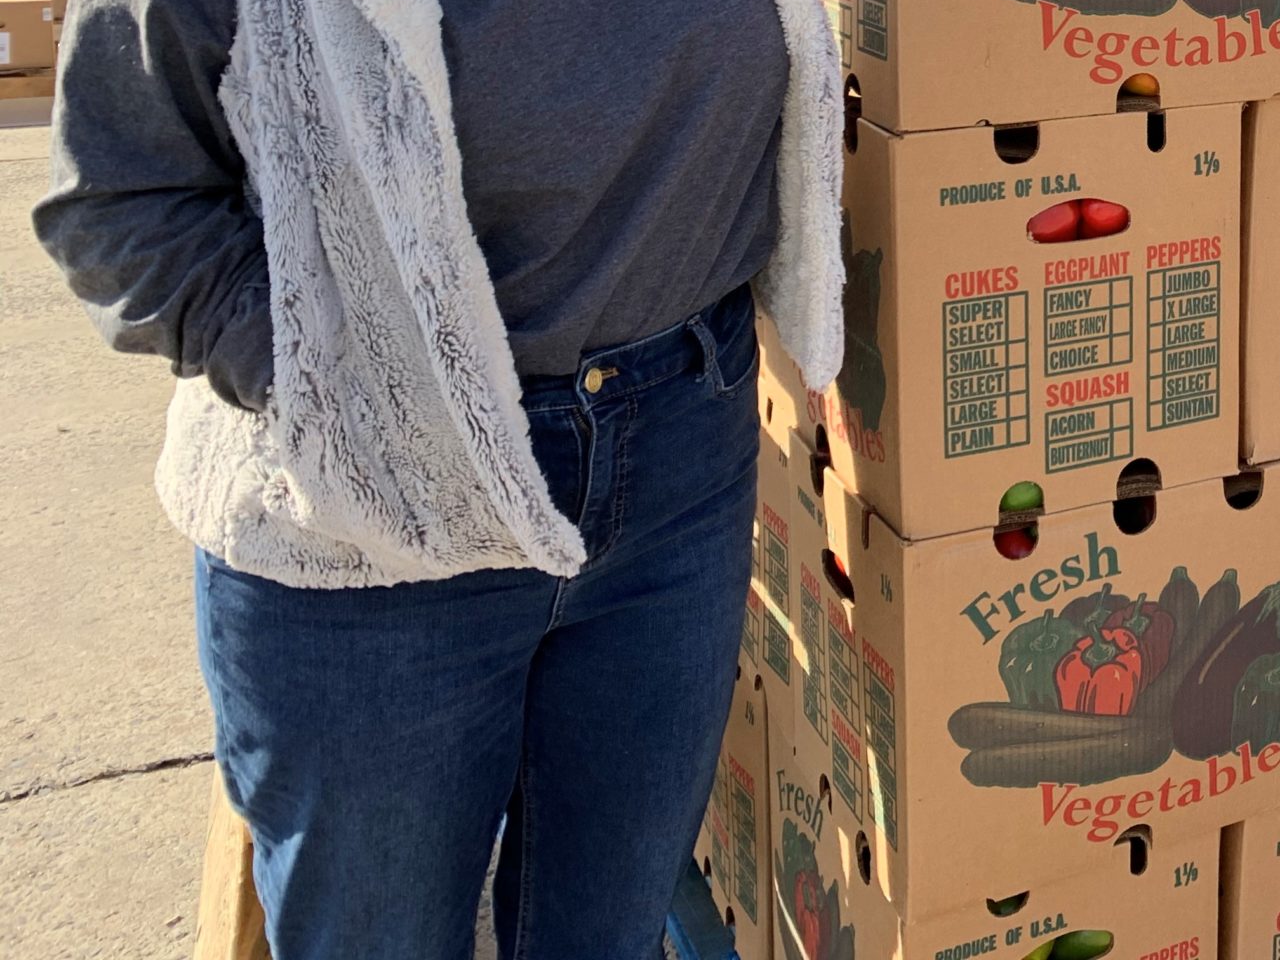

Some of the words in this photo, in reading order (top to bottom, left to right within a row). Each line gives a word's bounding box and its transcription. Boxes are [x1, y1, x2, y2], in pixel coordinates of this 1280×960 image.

[940, 181, 1005, 206] PRODUCE
[1015, 178, 1033, 197] OF
[1041, 173, 1081, 195] U.S.A.
[1146, 236, 1221, 269] PEPPERS
[1044, 251, 1130, 285] EGGPLANT
[1167, 269, 1210, 293] JUMBO
[945, 266, 1019, 299] CUKES
[949, 300, 1003, 325] SUPER
[1050, 288, 1092, 312] FANCY
[1167, 303, 1176, 319] X
[1178, 294, 1217, 317] LARGE
[949, 321, 1004, 347] SELECT
[1050, 319, 1077, 340] LARGE
[1079, 314, 1107, 336] FANCY
[1167, 322, 1205, 345] LARGE
[949, 349, 998, 373] SMALL
[1050, 345, 1098, 370] CHOICE
[1167, 346, 1216, 371] MEDIUM
[949, 373, 1004, 399] SELECT
[1046, 371, 1129, 408] SQUASH
[1167, 372, 1211, 396] SELECT
[950, 401, 997, 426] LARGE
[1166, 396, 1214, 422] SUNTAN
[1050, 411, 1095, 436] ACORN
[951, 427, 994, 452] PLAIN
[1050, 437, 1110, 467] BUTTERNUT
[763, 502, 789, 545] PEPPERS
[959, 531, 1121, 646] Fresh
[861, 636, 895, 692] PEPPERS
[776, 769, 824, 842] Fresh
[1005, 926, 1023, 946] OF
[1030, 913, 1068, 938] U.S.A.
